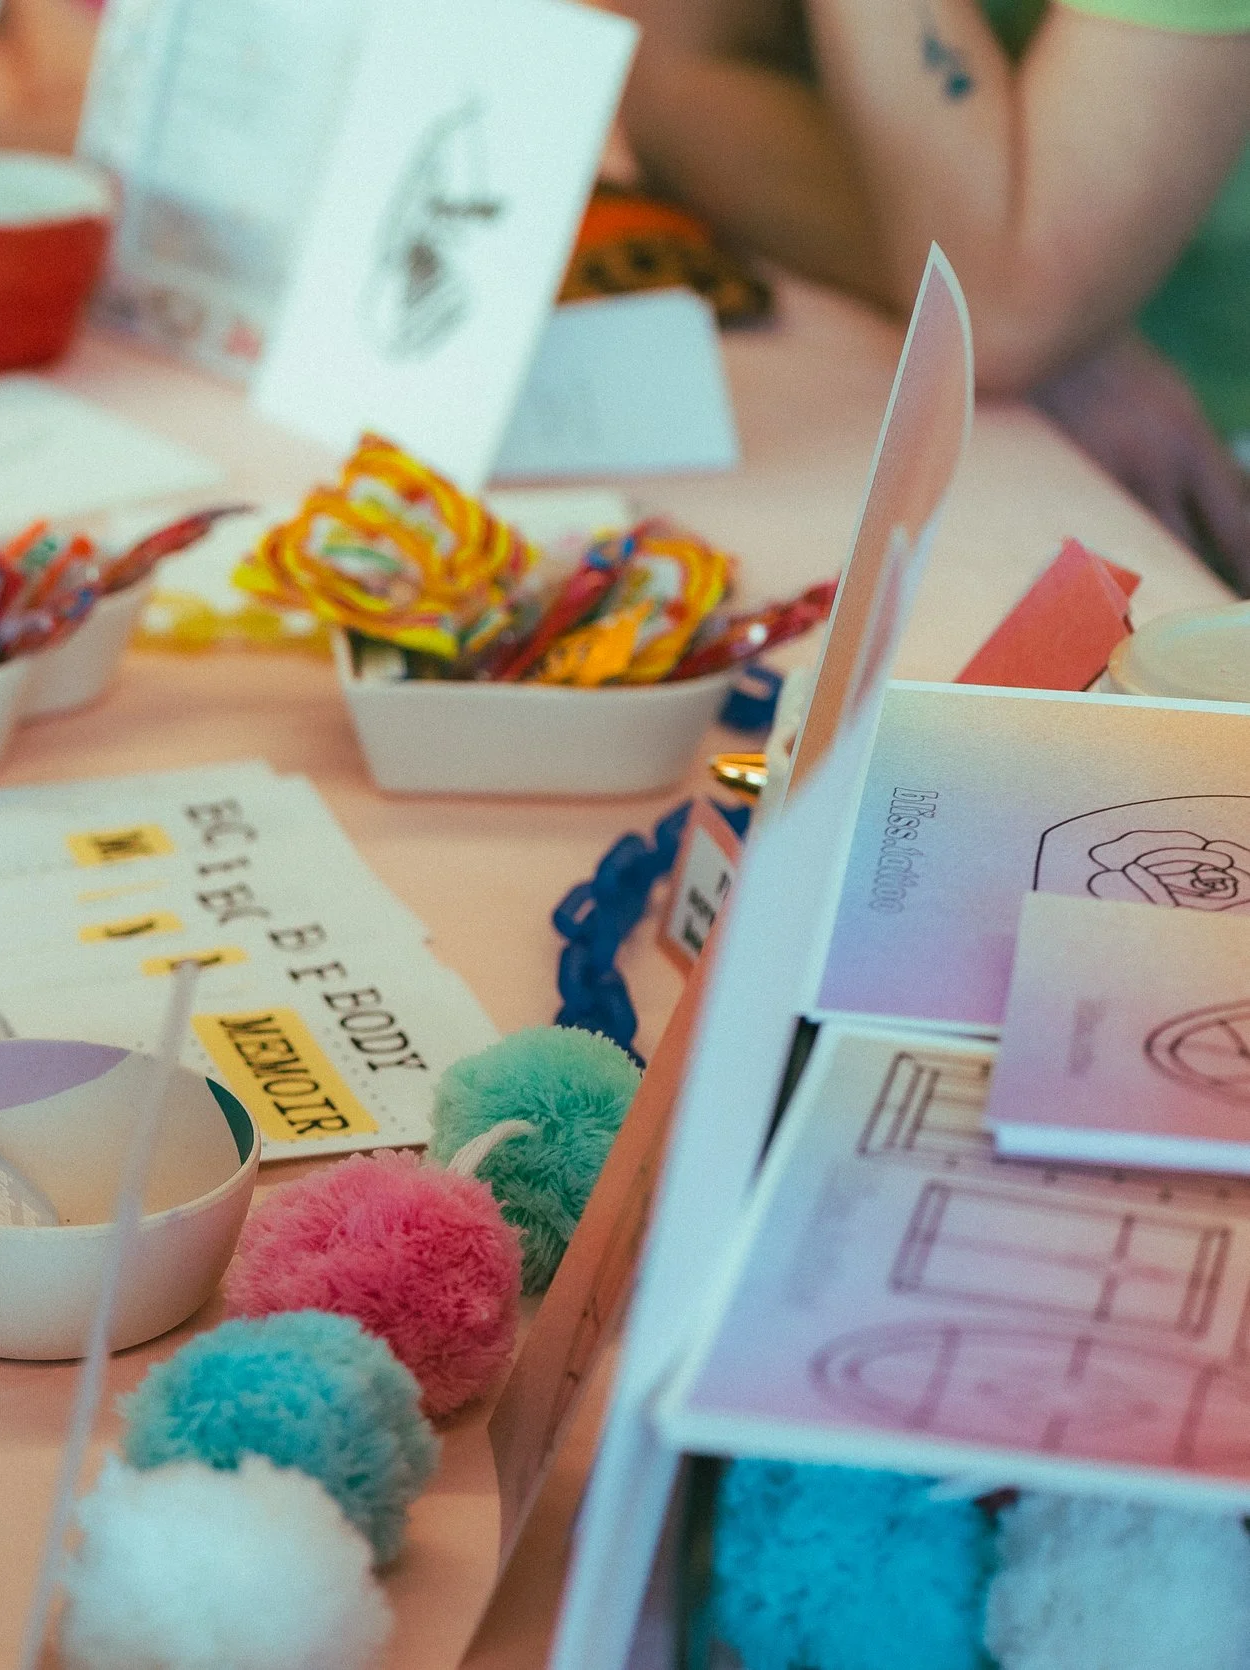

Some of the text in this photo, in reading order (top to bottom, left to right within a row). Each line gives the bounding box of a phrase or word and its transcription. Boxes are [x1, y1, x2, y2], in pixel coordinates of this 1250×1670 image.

[869, 786, 939, 914] bliss.tattoo
[219, 1014, 351, 1135] MEMOIR
[322, 985, 429, 1072] BODY
